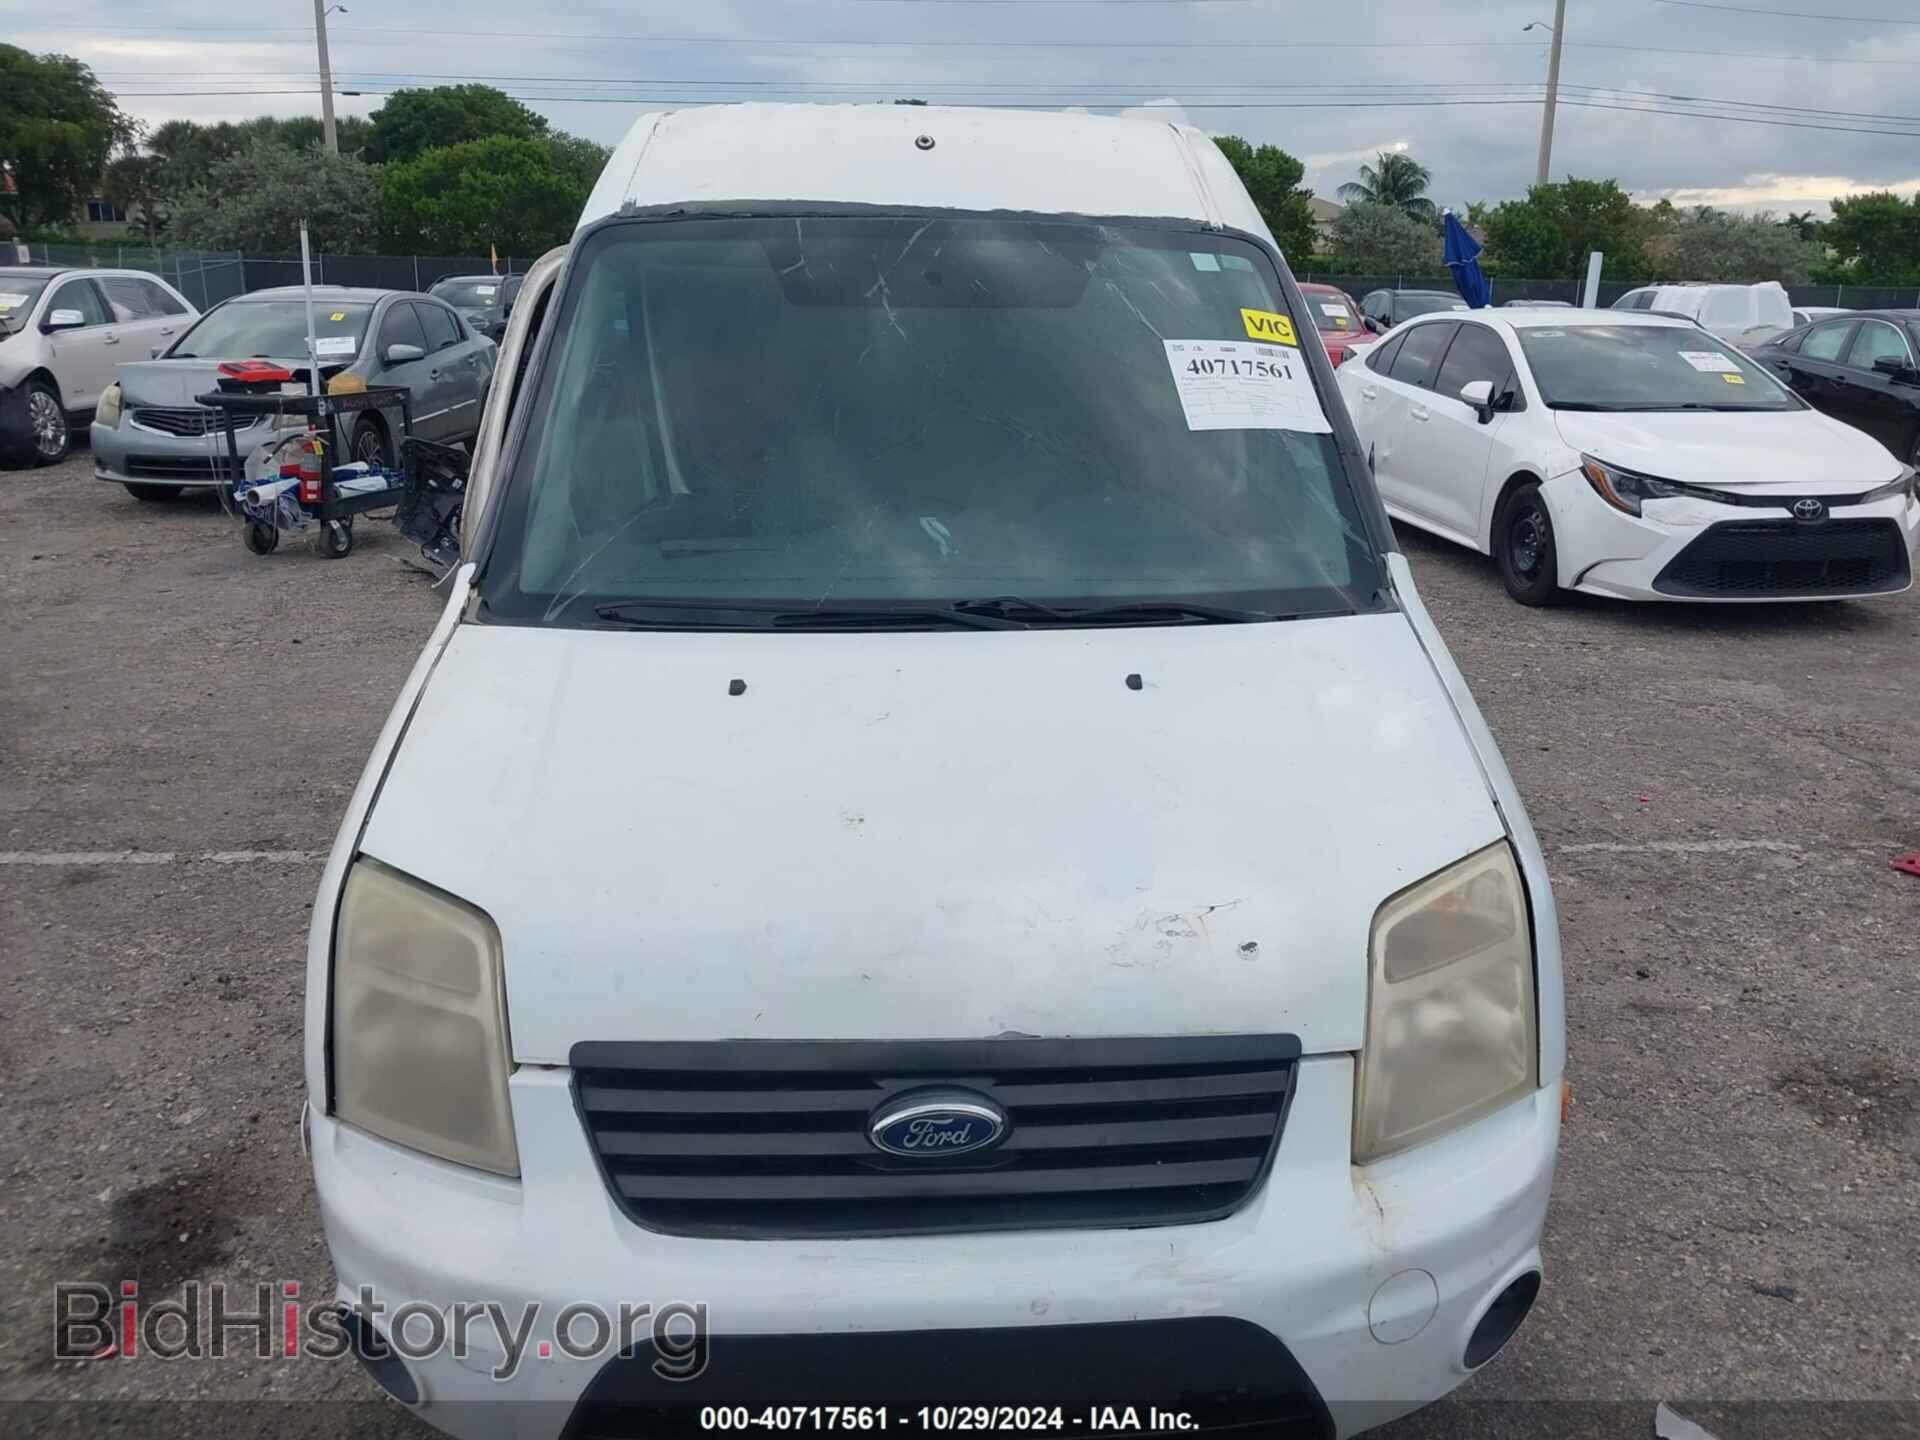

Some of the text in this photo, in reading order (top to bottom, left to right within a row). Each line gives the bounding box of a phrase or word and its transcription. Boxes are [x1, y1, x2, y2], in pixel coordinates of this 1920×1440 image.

[1248, 317, 1290, 336] VIC
[1187, 358, 1292, 380] 40717561
[903, 1118, 971, 1148] Ford
